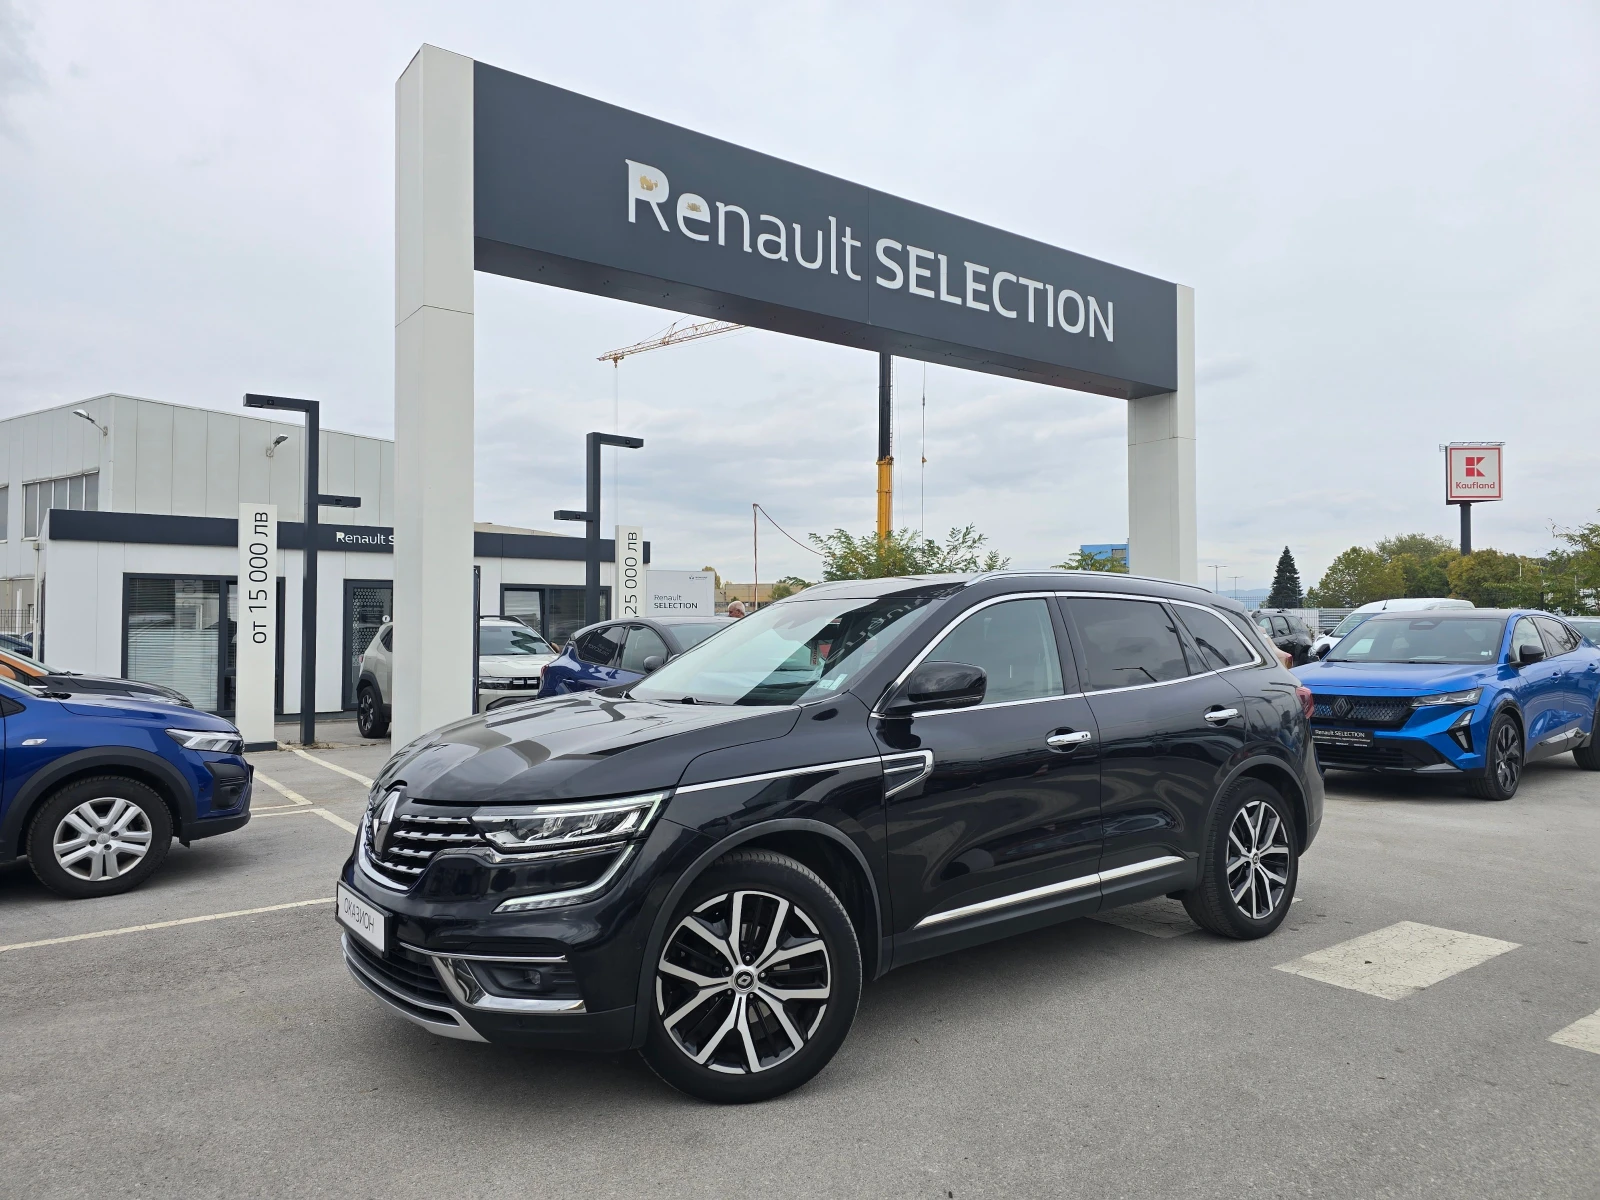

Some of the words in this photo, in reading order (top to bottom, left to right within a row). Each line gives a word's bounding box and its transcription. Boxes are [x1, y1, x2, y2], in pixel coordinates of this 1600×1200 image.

[624, 158, 862, 282] Renault
[875, 237, 1115, 343] SELECTION
[1455, 481, 1496, 489] Kaufland
[335, 531, 386, 545] Renault
[248, 543, 268, 583] 000
[624, 557, 638, 589] 000
[248, 589, 268, 613] 15
[624, 594, 638, 614] 25
[344, 897, 375, 933] ОКАЗИОН
